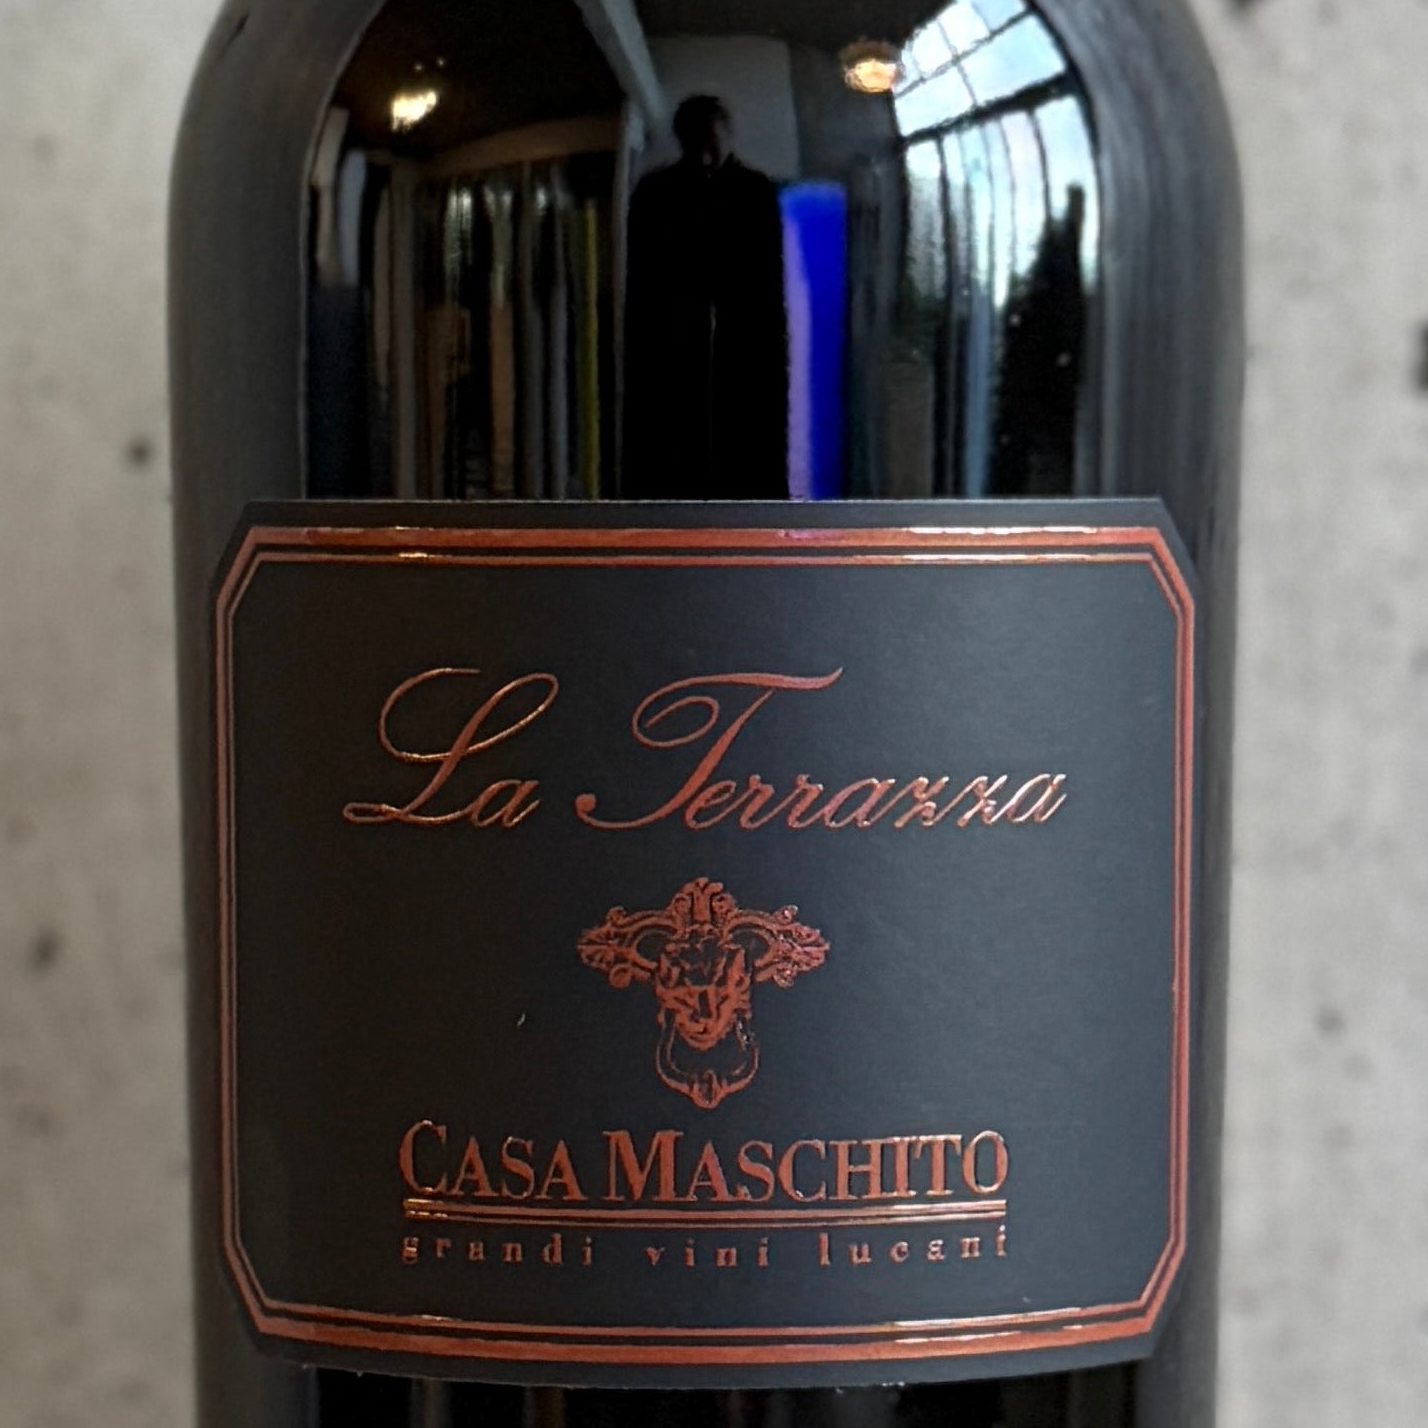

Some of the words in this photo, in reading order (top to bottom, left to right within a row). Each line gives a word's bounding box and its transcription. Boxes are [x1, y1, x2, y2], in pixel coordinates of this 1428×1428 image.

[343, 667, 559, 828] La
[576, 667, 1067, 830] Terrazza
[401, 1230, 596, 1266] grandi
[644, 1236, 772, 1269] vini
[817, 1224, 1009, 1268] lucani
